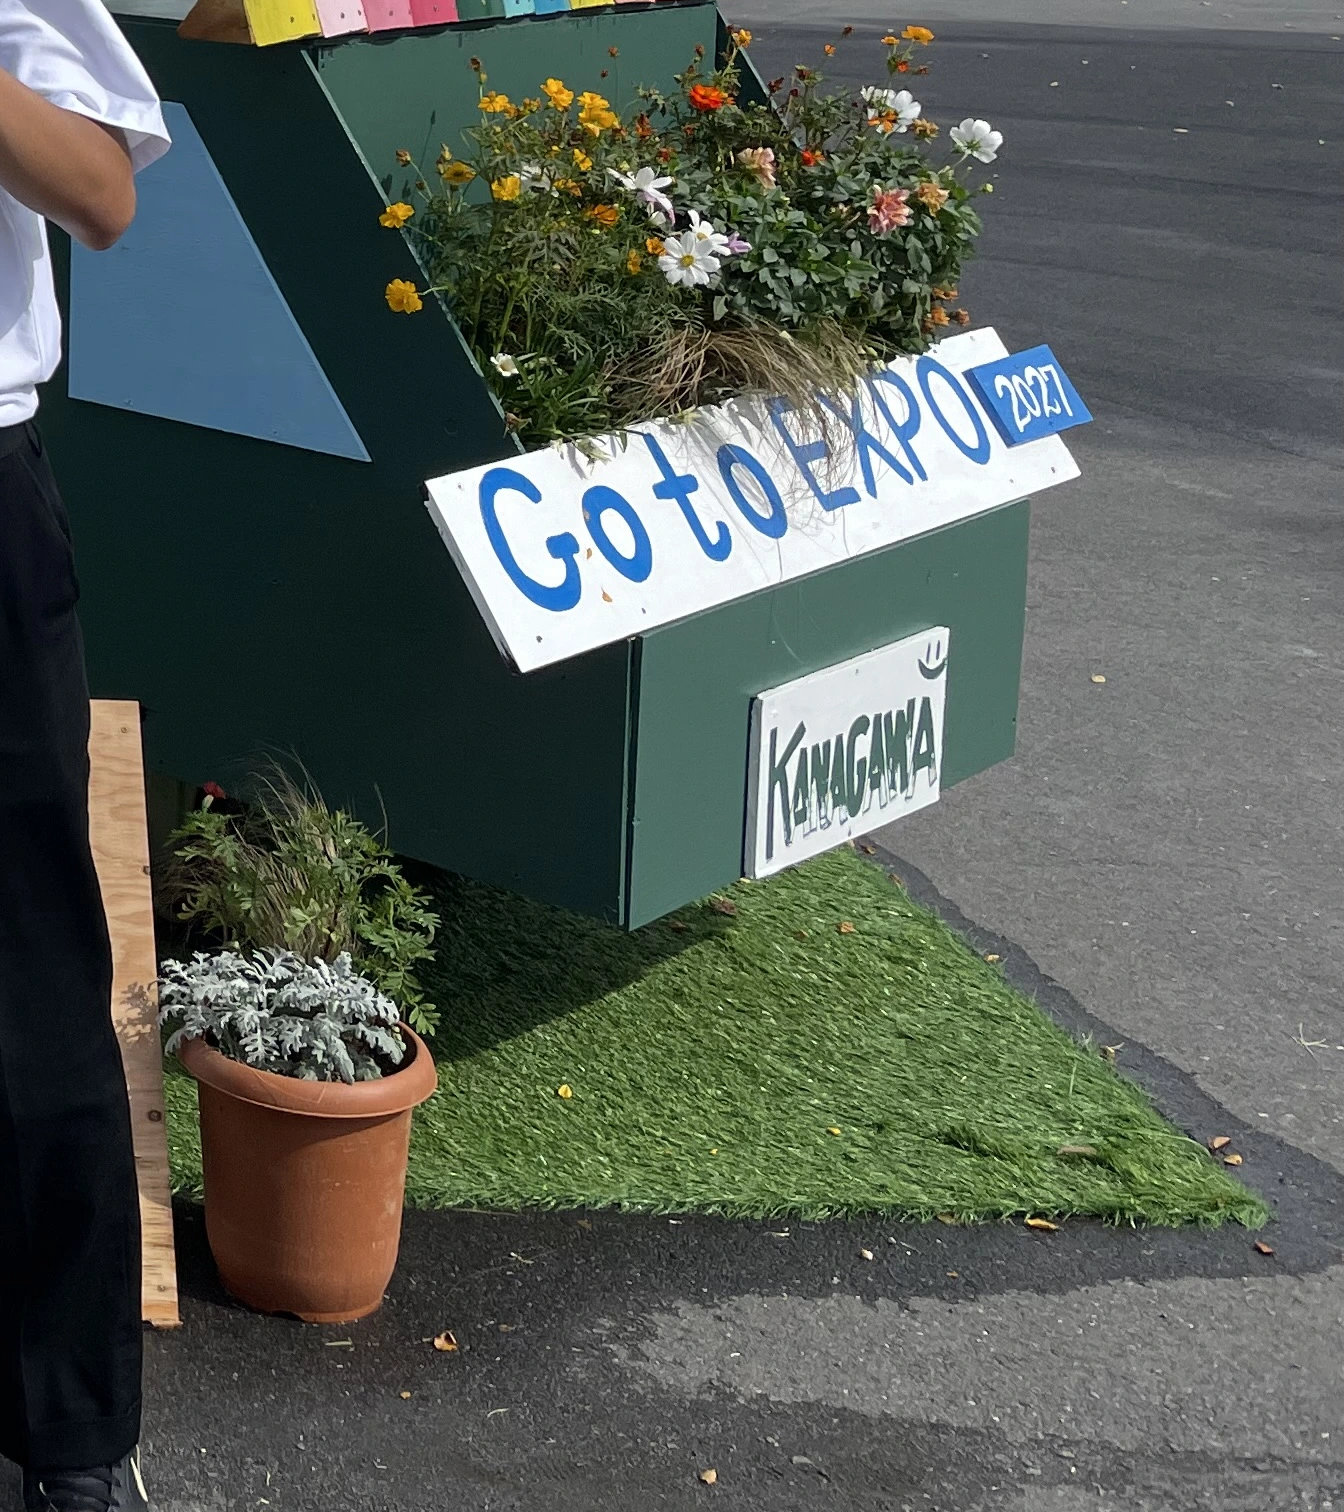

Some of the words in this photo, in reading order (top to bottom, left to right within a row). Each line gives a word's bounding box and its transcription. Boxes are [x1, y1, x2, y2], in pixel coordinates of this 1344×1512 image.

[995, 364, 1074, 433] 2027
[479, 468, 652, 611] Go
[643, 432, 787, 562] to
[765, 355, 991, 511] EXPO
[765, 696, 938, 861] KANAGAWA
